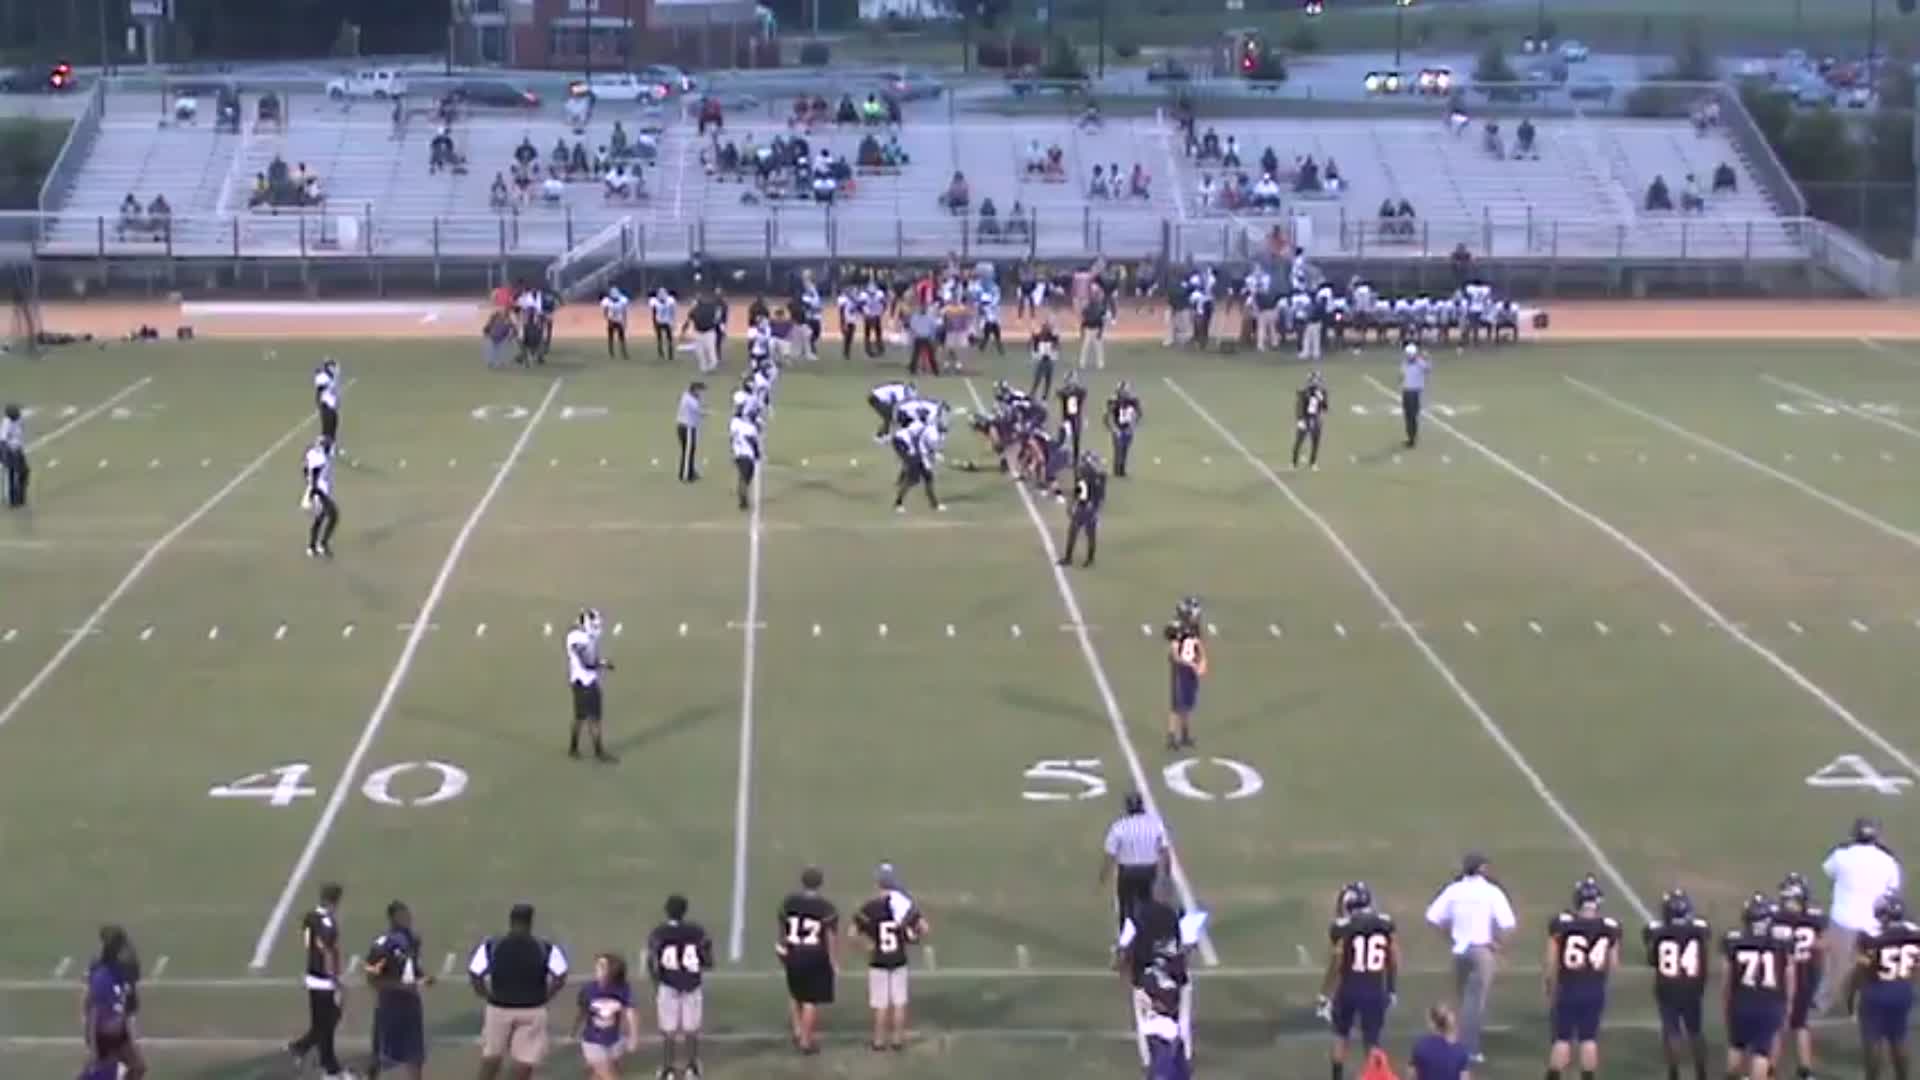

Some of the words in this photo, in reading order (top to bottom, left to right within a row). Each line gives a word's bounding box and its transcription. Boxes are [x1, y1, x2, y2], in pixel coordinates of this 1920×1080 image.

[208, 761, 469, 806] 40
[1022, 756, 1264, 800] 50
[879, 921, 898, 953] 5
[1351, 934, 1388, 972] 16
[1563, 934, 1609, 970] 64
[661, 944, 700, 972] 44
[1658, 940, 1699, 978] 84
[1736, 950, 1776, 988] 71
